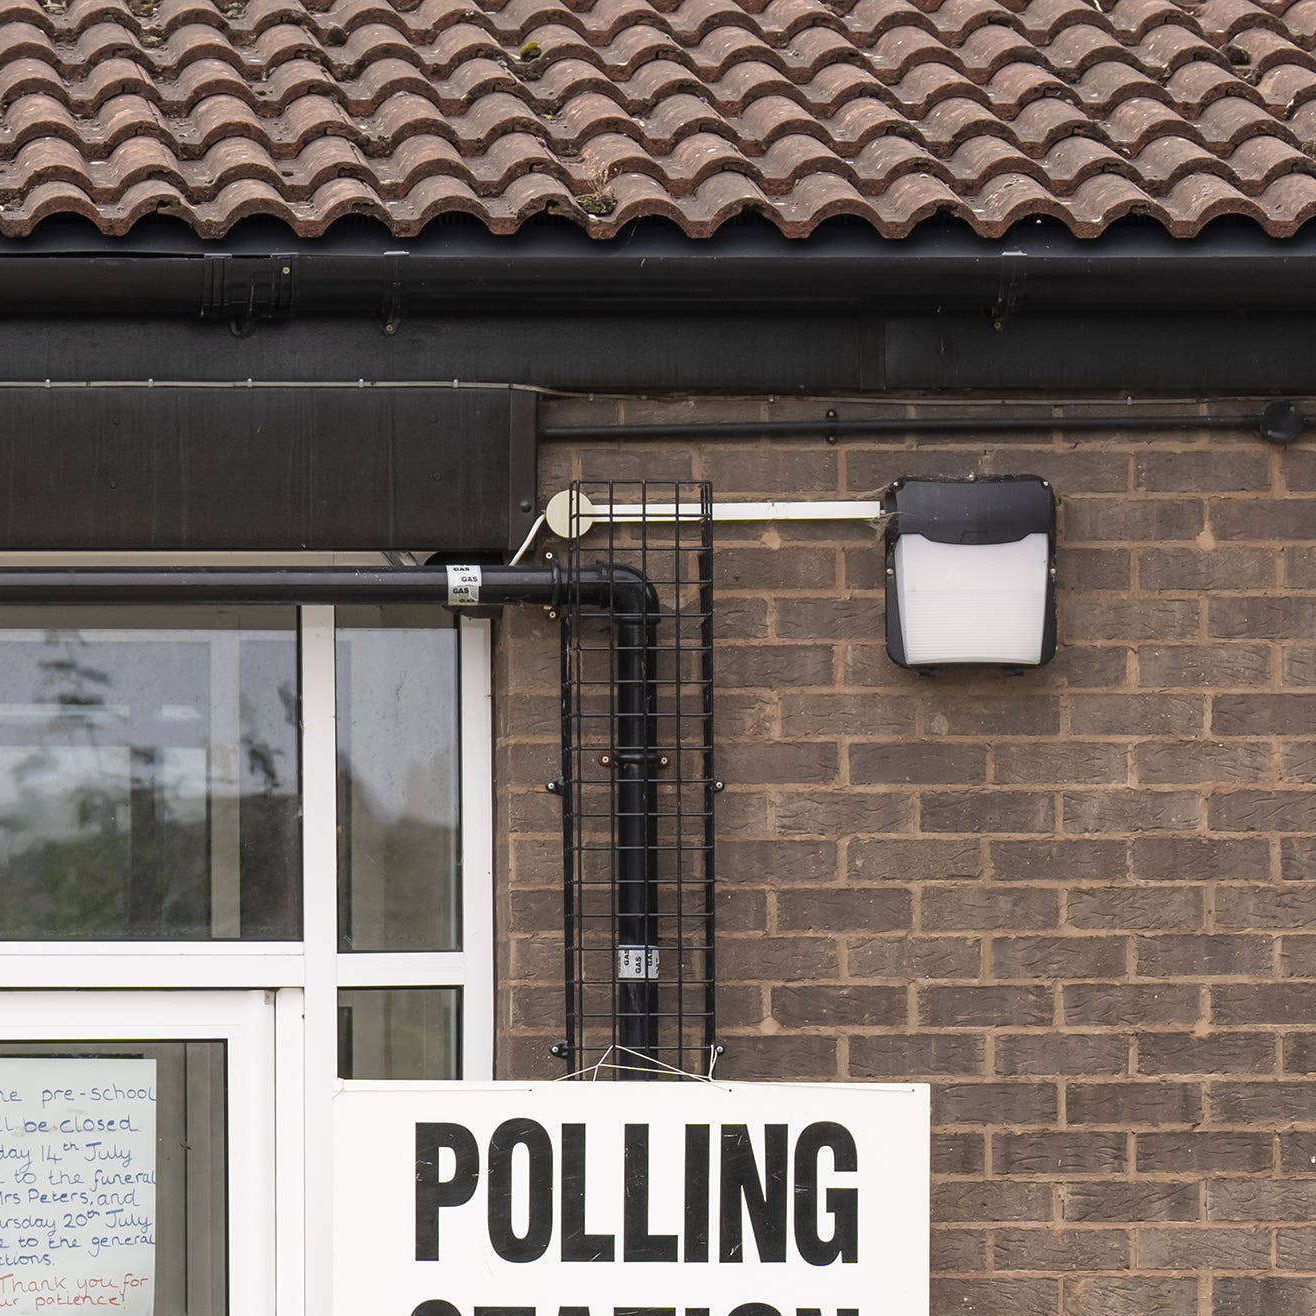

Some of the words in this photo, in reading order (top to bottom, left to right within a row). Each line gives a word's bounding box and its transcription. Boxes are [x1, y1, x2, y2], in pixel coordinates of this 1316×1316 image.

[23, 1117, 49, 1133] be
[59, 1115, 138, 1134] closed
[84, 1142, 133, 1168] July
[14, 1172, 37, 1185] to
[48, 1170, 83, 1186] the
[90, 1169, 157, 1193] funeral
[415, 1117, 858, 1266] POLLING
[97, 1189, 141, 1207] and
[105, 1208, 153, 1234] July
[18, 1236, 39, 1249] to
[48, 1236, 83, 1250] the
[88, 1233, 156, 1258] general
[76, 1276, 119, 1297] you
[123, 1273, 149, 1294] for
